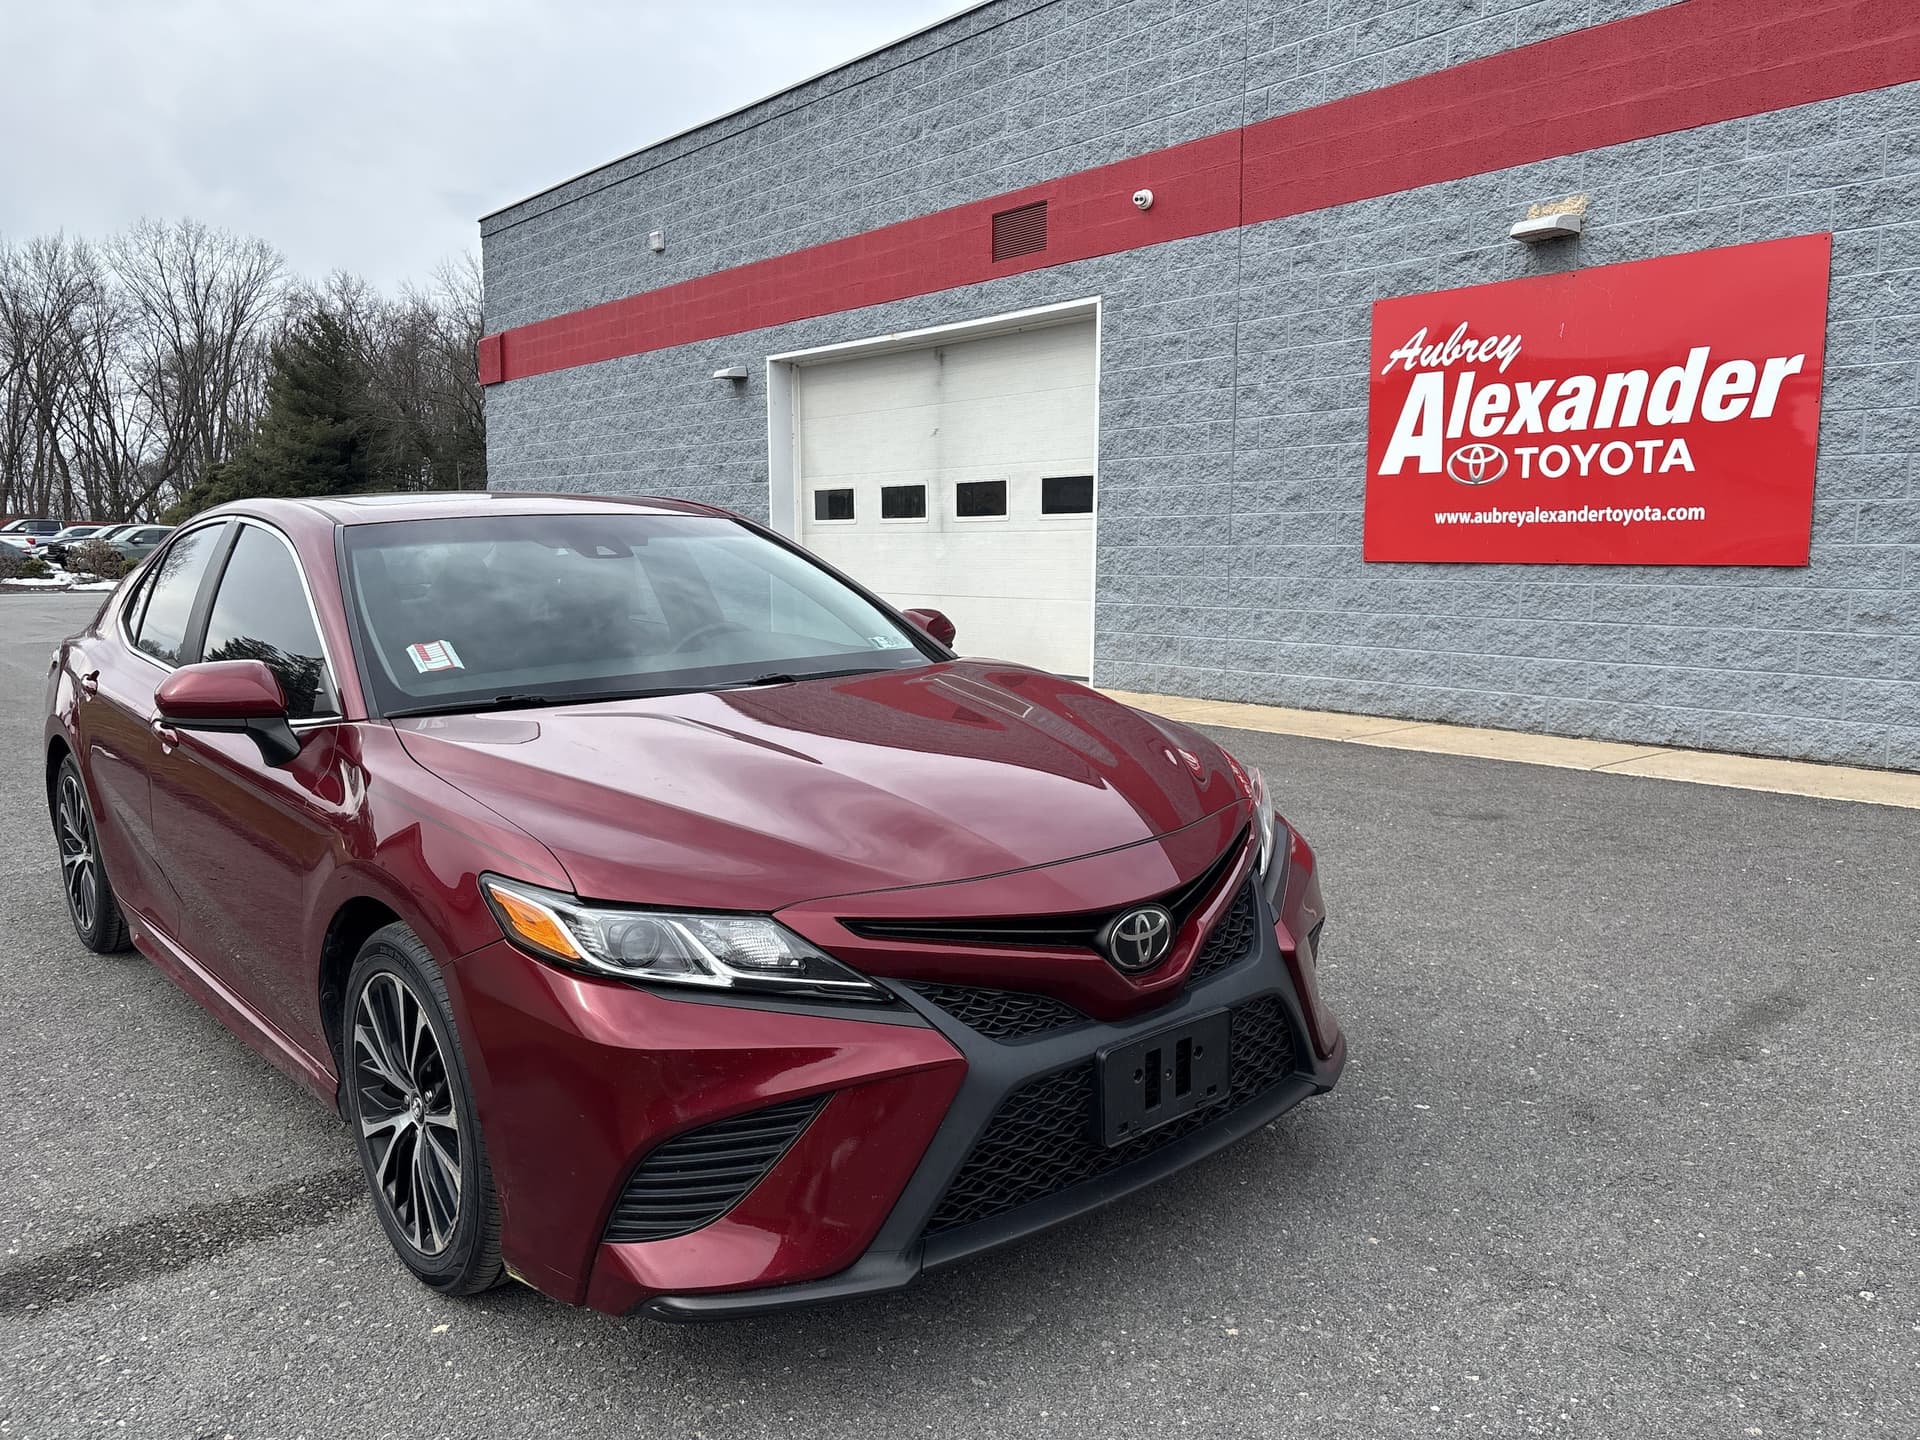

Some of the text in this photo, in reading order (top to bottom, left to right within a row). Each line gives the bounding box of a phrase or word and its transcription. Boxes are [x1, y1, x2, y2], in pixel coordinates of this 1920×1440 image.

[1381, 321, 1522, 375] Aubrey
[1378, 346, 1805, 475] Alexander
[1514, 438, 1696, 479] TOYOTA
[1434, 504, 1706, 527] www.aubreyalexandertoyota.com
